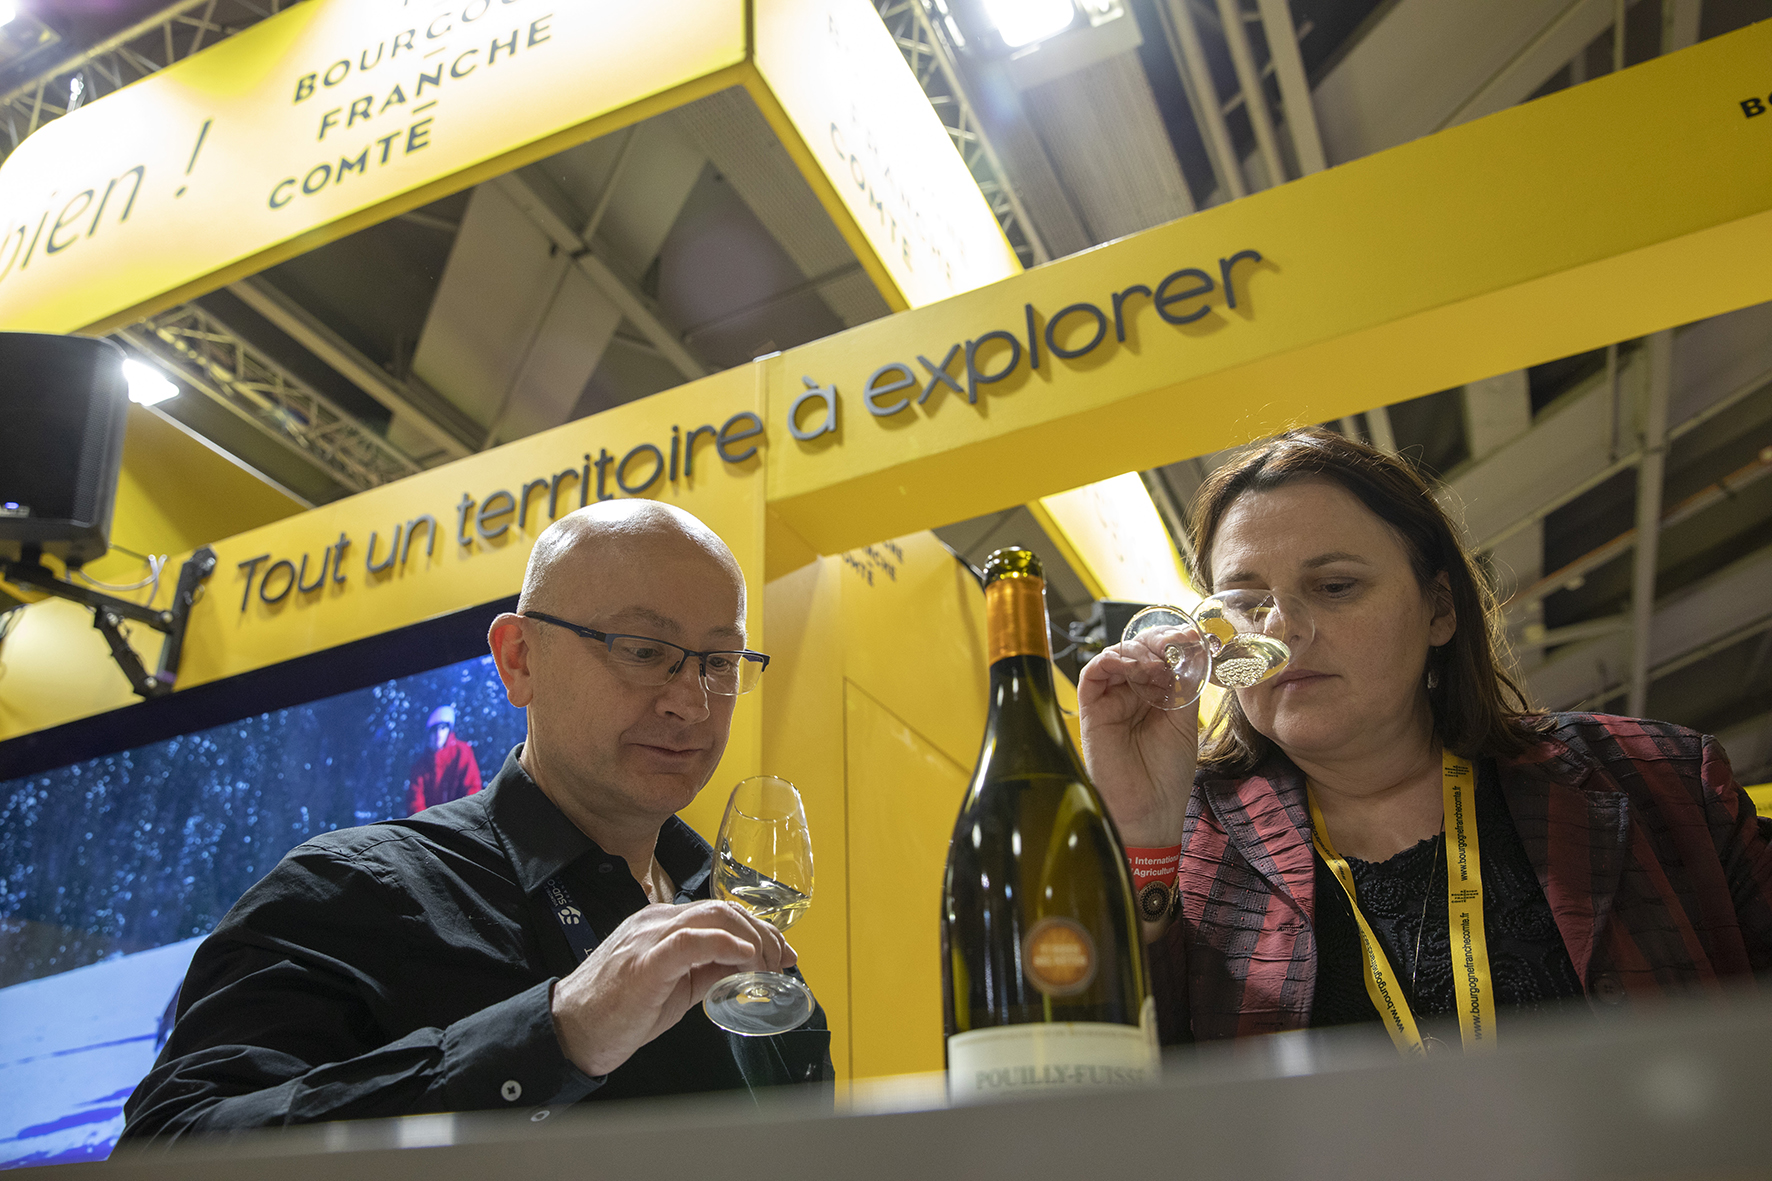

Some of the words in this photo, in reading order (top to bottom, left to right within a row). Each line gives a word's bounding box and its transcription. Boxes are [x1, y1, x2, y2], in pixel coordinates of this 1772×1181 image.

[317, 13, 555, 142] FRANCHE
[237, 532, 351, 613] Tout
[366, 512, 436, 574] un
[456, 410, 764, 546] territoire
[787, 375, 837, 441] à
[863, 249, 1263, 417] explorer
[1135, 852, 1180, 865] International
[1461, 911, 1483, 1041] www.bourgognefranchecomte.fr
